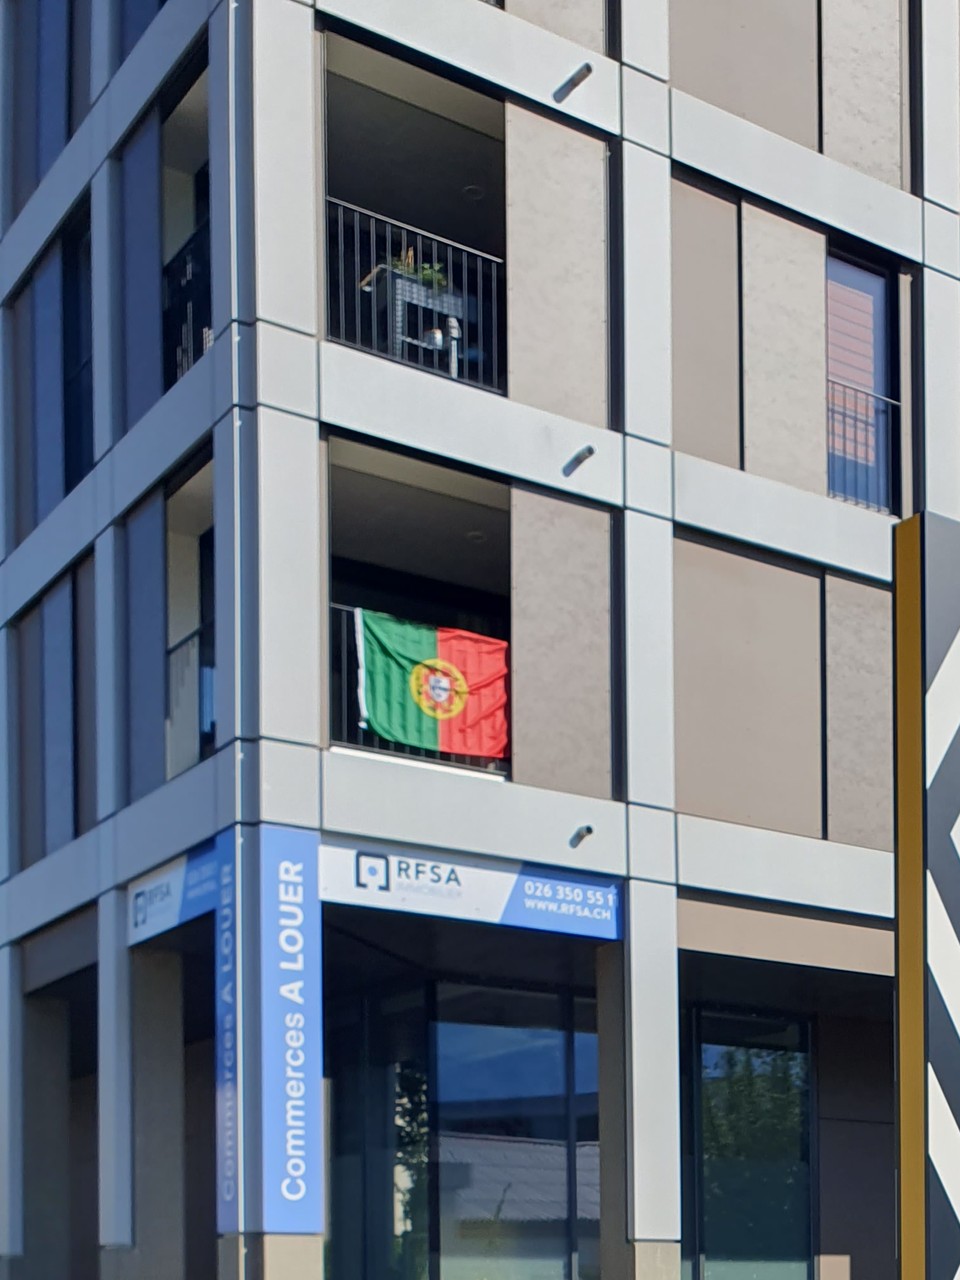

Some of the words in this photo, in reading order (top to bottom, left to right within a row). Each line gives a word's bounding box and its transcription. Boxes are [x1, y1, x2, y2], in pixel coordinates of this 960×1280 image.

[397, 860, 462, 887] RFSA
[524, 880, 552, 898] 026
[556, 885, 583, 903] 350
[278, 860, 304, 971] LOUER
[524, 897, 611, 920] WWW.RFSA.CH
[279, 980, 304, 1005] A
[281, 1012, 306, 1202] Commerces
